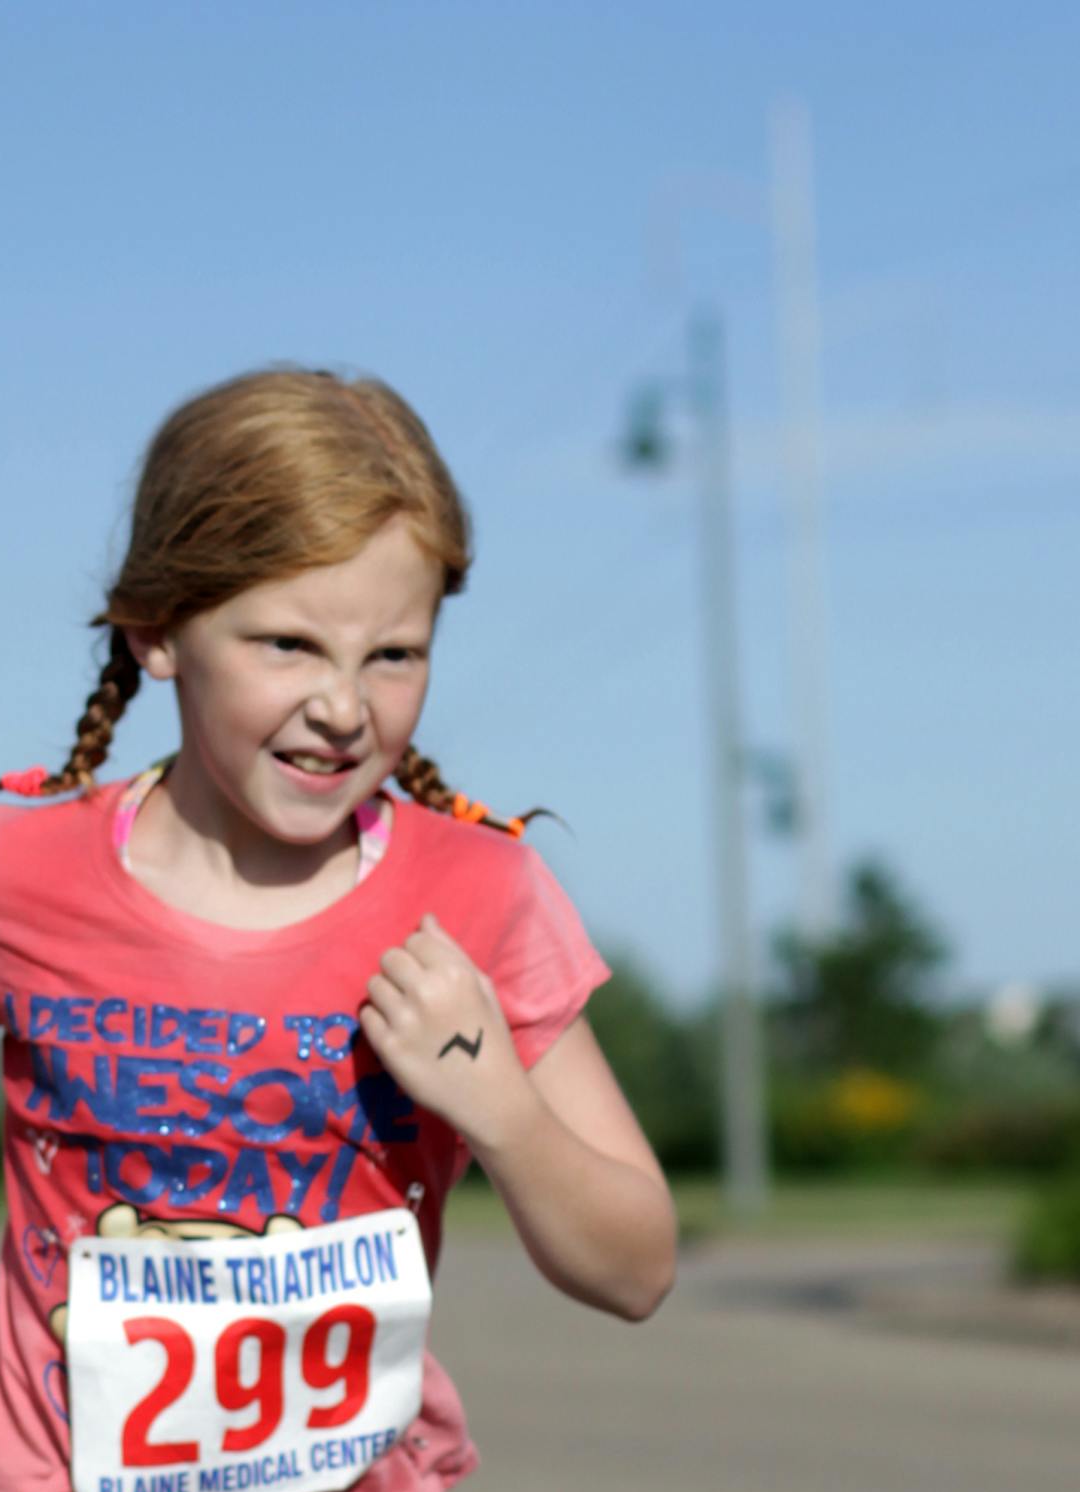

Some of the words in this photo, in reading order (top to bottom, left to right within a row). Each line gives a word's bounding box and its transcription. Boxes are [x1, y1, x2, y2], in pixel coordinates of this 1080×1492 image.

[29, 995, 267, 1055] DECIDED
[283, 1012, 361, 1062] TO
[25, 1040, 418, 1142] AWESOME
[58, 1133, 358, 1222] TODAY!
[98, 1253, 218, 1304] BLAINE
[226, 1231, 398, 1306] TRIATHLON
[122, 1303, 378, 1468] 299
